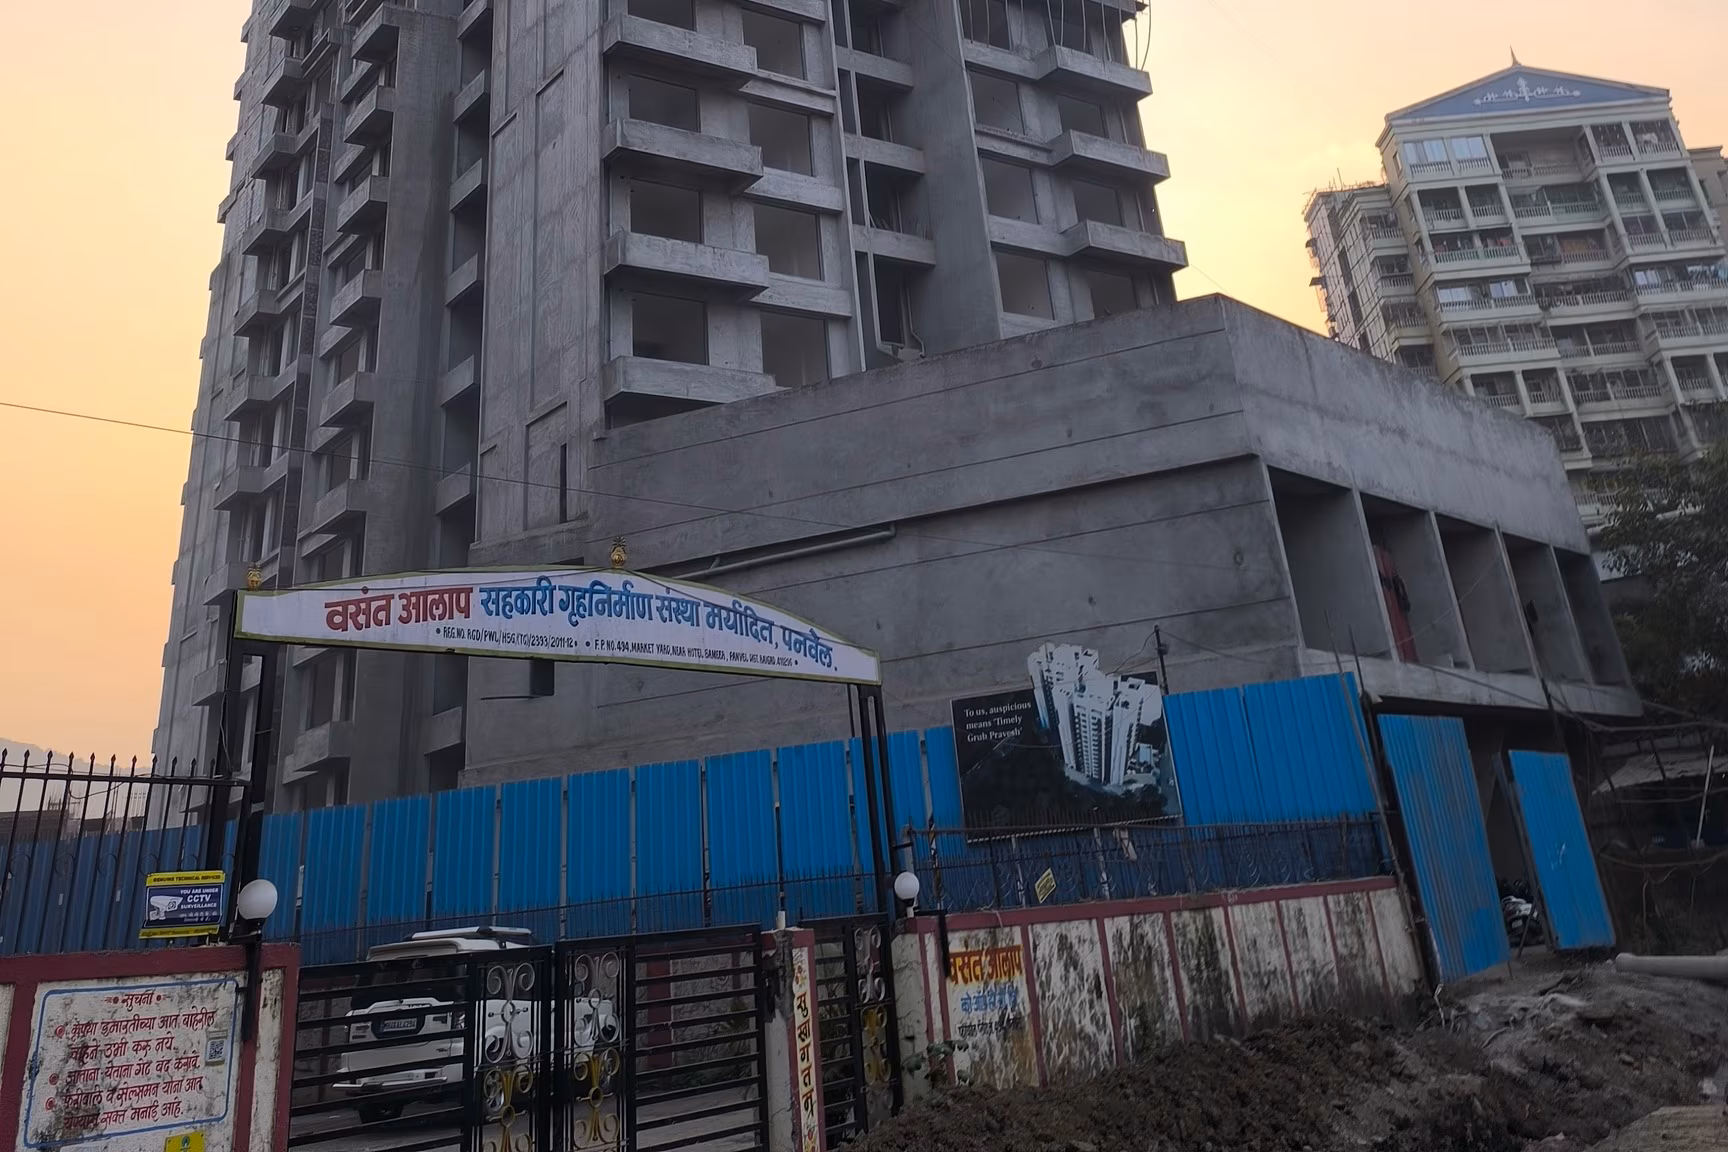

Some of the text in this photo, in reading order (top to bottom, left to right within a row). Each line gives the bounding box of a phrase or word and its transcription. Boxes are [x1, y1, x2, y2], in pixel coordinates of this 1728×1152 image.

[325, 586, 394, 632] वसंत
[398, 587, 473, 624] आलाप
[479, 575, 556, 619] सहकारी
[558, 579, 653, 627] गृहनिर्माण
[655, 587, 701, 627] संस्था
[964, 709, 975, 717] To
[989, 702, 1031, 714] auspicious
[966, 720, 992, 730] means
[187, 894, 211, 903] CCTV
[158, 1014, 179, 1030] आत
